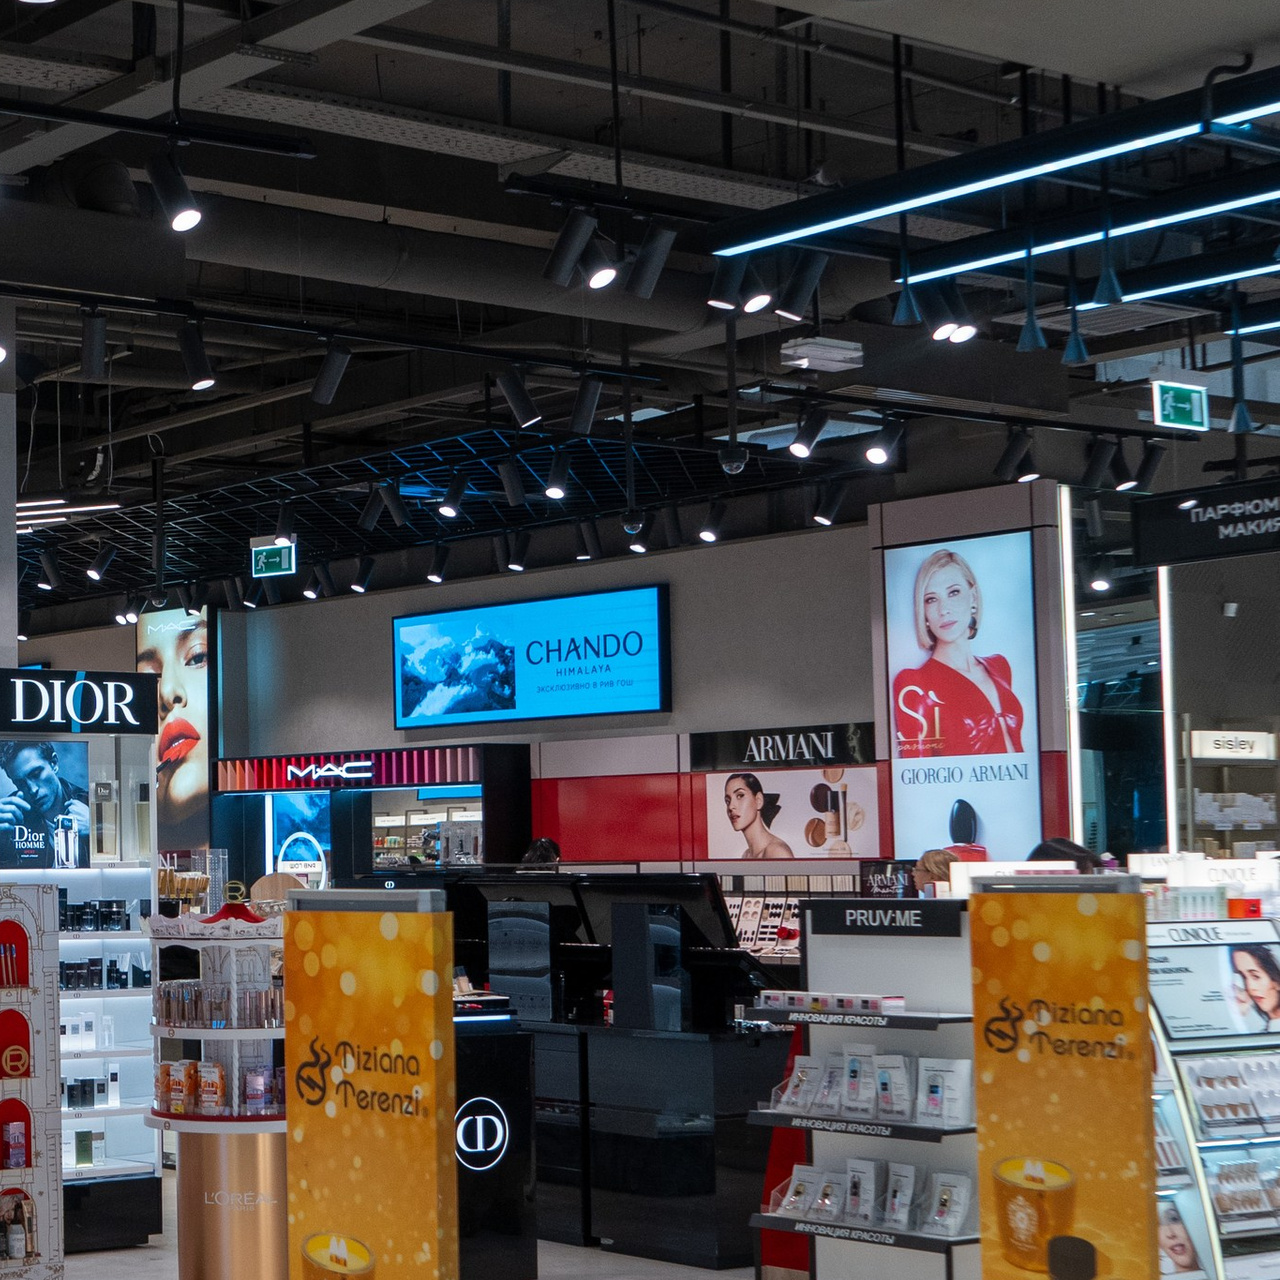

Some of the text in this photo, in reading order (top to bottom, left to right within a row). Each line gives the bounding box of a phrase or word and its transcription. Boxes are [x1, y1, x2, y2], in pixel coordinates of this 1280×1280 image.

[526, 630, 643, 665] CHANDO
[556, 664, 611, 677] HIMALAYA
[536, 683, 590, 693] ЭКСКЛЮЗИВНО
[10, 678, 140, 725] DIOR
[742, 732, 835, 762] ARMANI
[1213, 736, 1255, 752] sisley
[901, 764, 1029, 785] GIORGIO ARMANI
[14, 825, 45, 841] Dior
[15, 841, 45, 849] HOMME
[867, 873, 908, 886] ARMANI
[845, 909, 923, 927] PRUV:ME
[1168, 927, 1223, 943] CLINIQUE
[789, 1012, 888, 1026] ИННОВАЦИЯ КРАСОТЫ
[1027, 999, 1124, 1026] Tiziana
[1028, 1031, 1126, 1059] Terenzi
[335, 1041, 420, 1076] Tiziana
[336, 1080, 421, 1116] Terenzi
[791, 1117, 891, 1136] ИННОВАЦИЯ КРАСОТЫ
[794, 1222, 895, 1244] ИННОВАЦИЯ КРАСОТЫ
